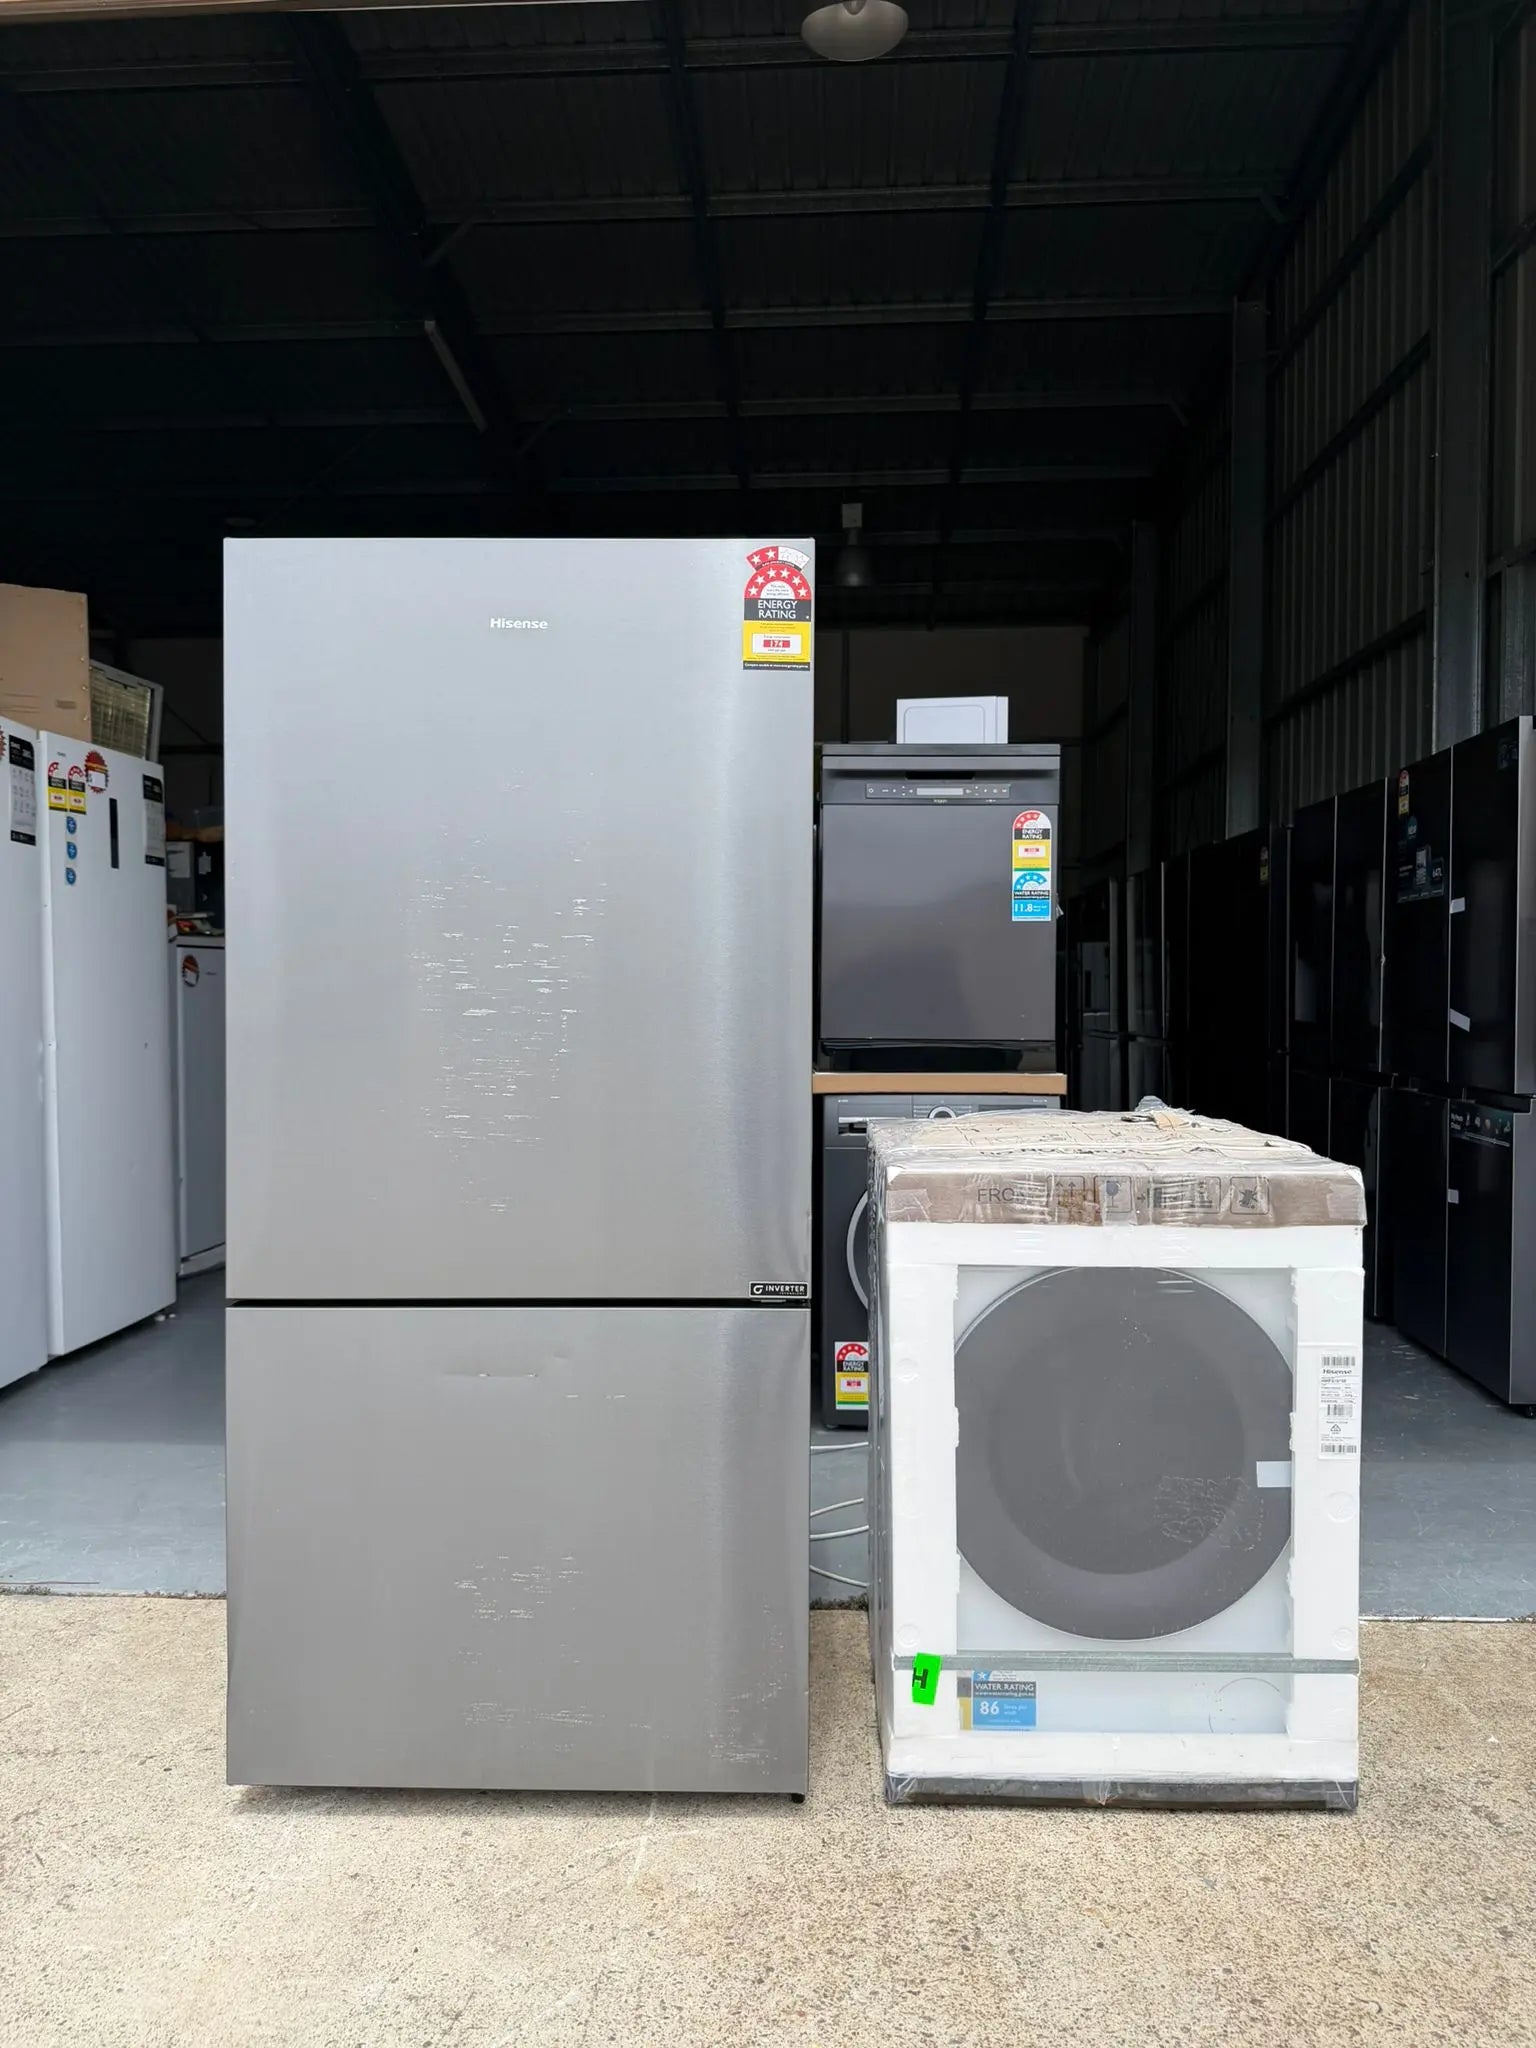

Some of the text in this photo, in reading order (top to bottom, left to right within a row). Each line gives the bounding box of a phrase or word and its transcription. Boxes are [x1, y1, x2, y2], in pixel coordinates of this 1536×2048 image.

[757, 599, 798, 610] ENERGY
[758, 610, 797, 620] RATING
[490, 617, 548, 629] Hisense
[1015, 903, 1033, 912] 11.8
[765, 1285, 805, 1293] INVERTER
[911, 1667, 929, 1690] H
[1004, 1683, 1034, 1691] RATING
[980, 1700, 1000, 1715] 86
